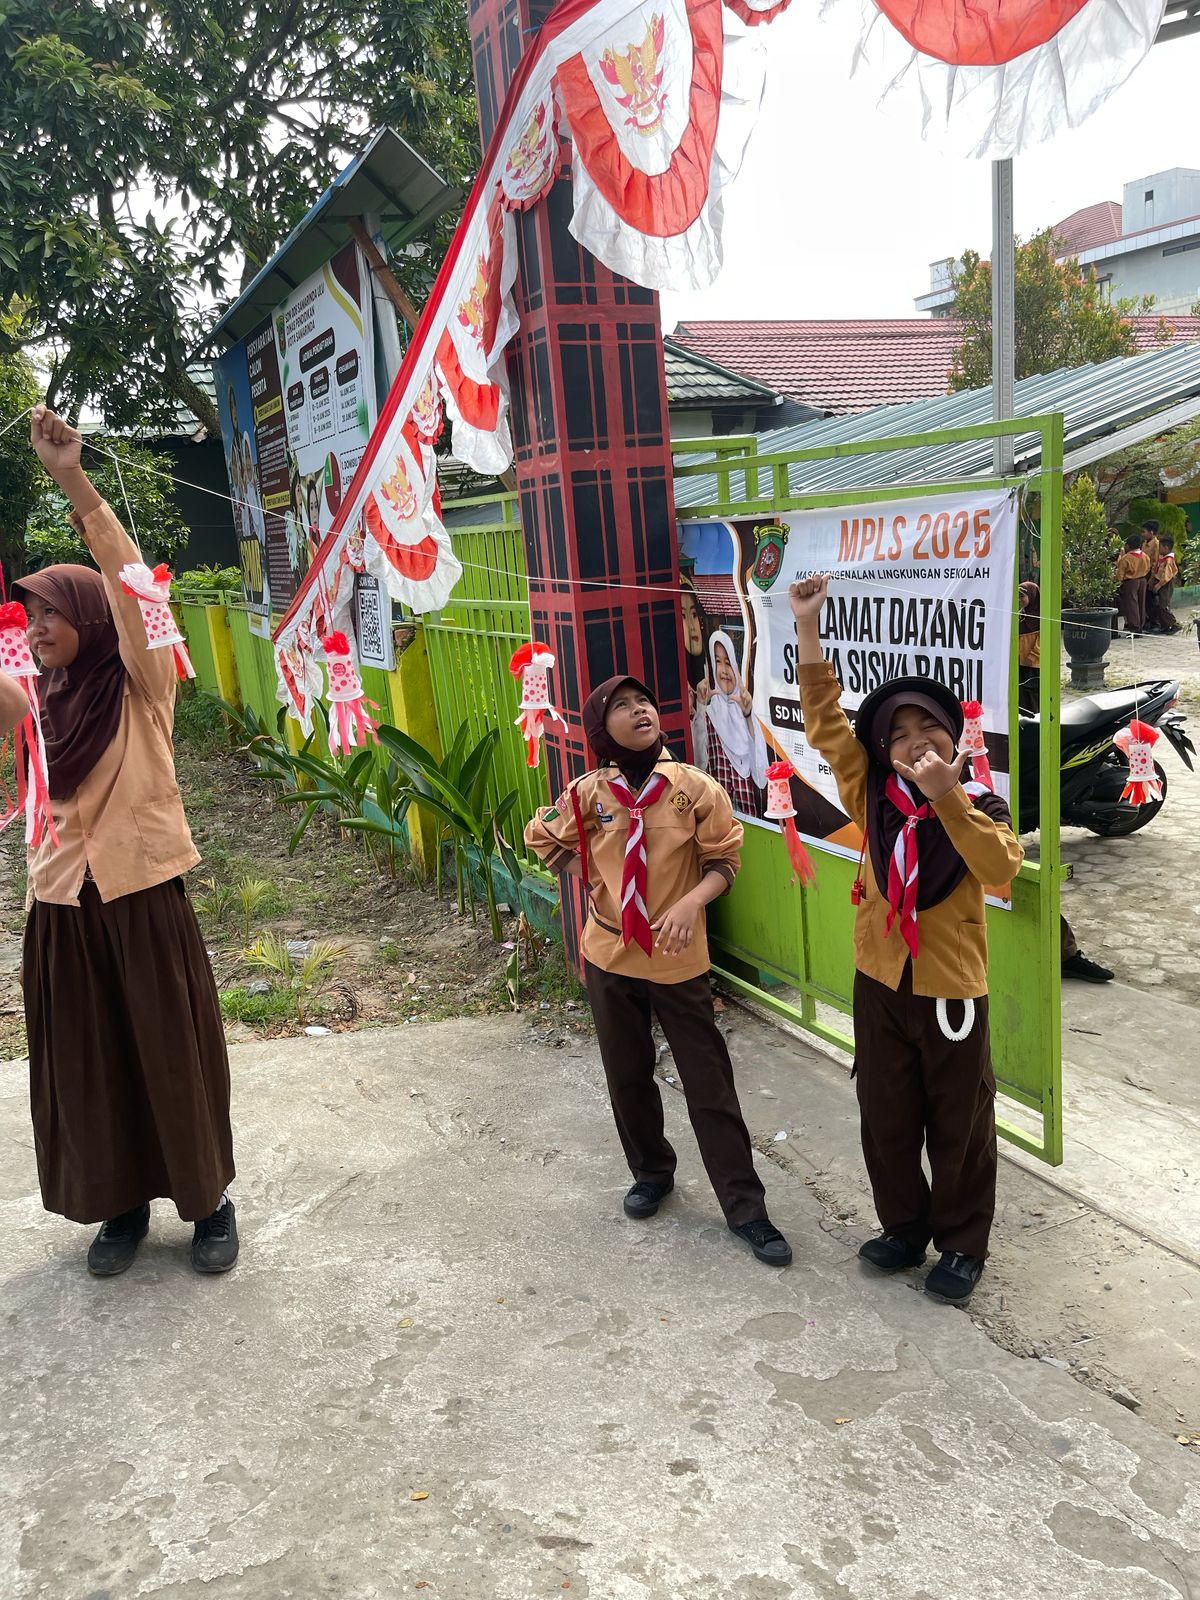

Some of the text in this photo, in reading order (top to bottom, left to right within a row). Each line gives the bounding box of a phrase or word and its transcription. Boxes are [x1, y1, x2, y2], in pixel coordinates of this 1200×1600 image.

[837, 509, 991, 562] MPLS 2025
[877, 568, 941, 580] LINGKUNGAN
[943, 567, 990, 580] SEKOLAH
[794, 597, 985, 651] LAMAT DATANG
[775, 704, 790, 720] SD
